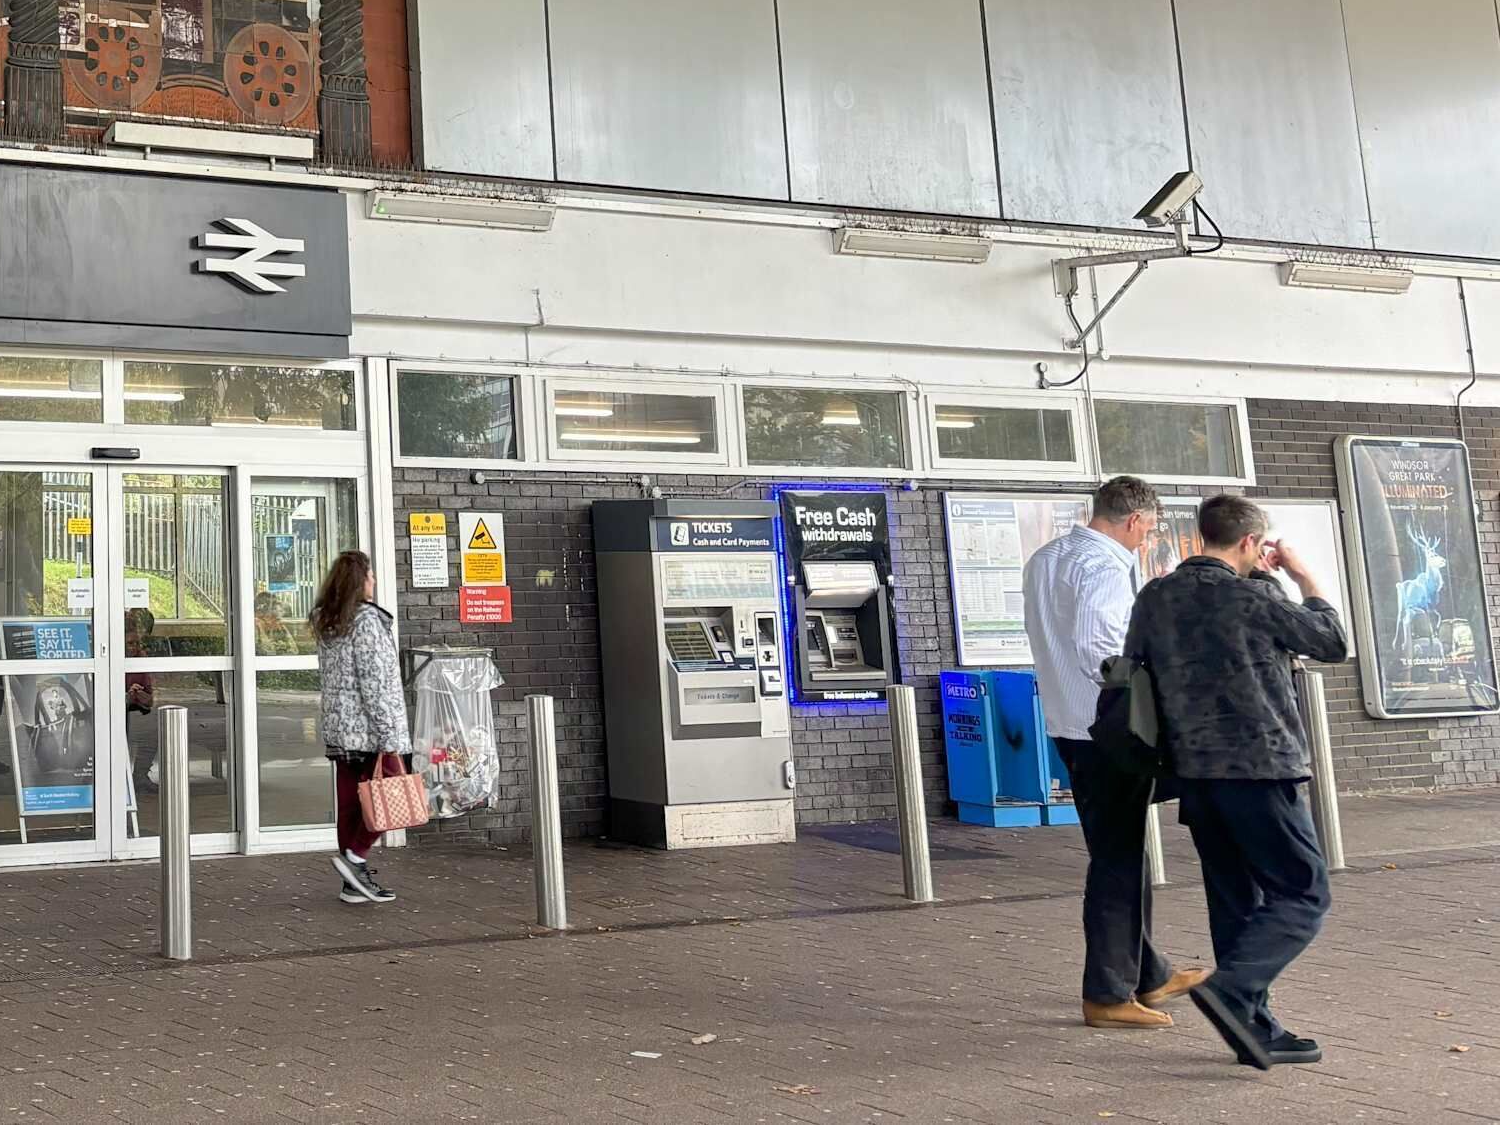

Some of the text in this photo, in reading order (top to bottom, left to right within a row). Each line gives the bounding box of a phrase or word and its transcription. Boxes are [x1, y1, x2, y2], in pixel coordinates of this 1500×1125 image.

[1390, 460, 1429, 470] WINDSOR
[1388, 471, 1436, 482] GREAT PARK
[795, 506, 877, 526] Free Cash
[1175, 510, 1195, 519] times
[692, 522, 733, 534] TICKETS
[801, 527, 874, 542] withdrawals
[693, 538, 770, 547] Cash and Card Payments
[466, 588, 487, 596] Warning
[483, 599, 505, 607] trespass
[483, 606, 502, 614] Railway
[37, 627, 73, 639] SEE IT.
[39, 638, 60, 650] SAY
[61, 638, 74, 650] IT.
[40, 649, 87, 659] SORTED
[947, 683, 977, 698] METRO
[948, 713, 981, 726] MORNINGS
[949, 731, 982, 743] TALKING
